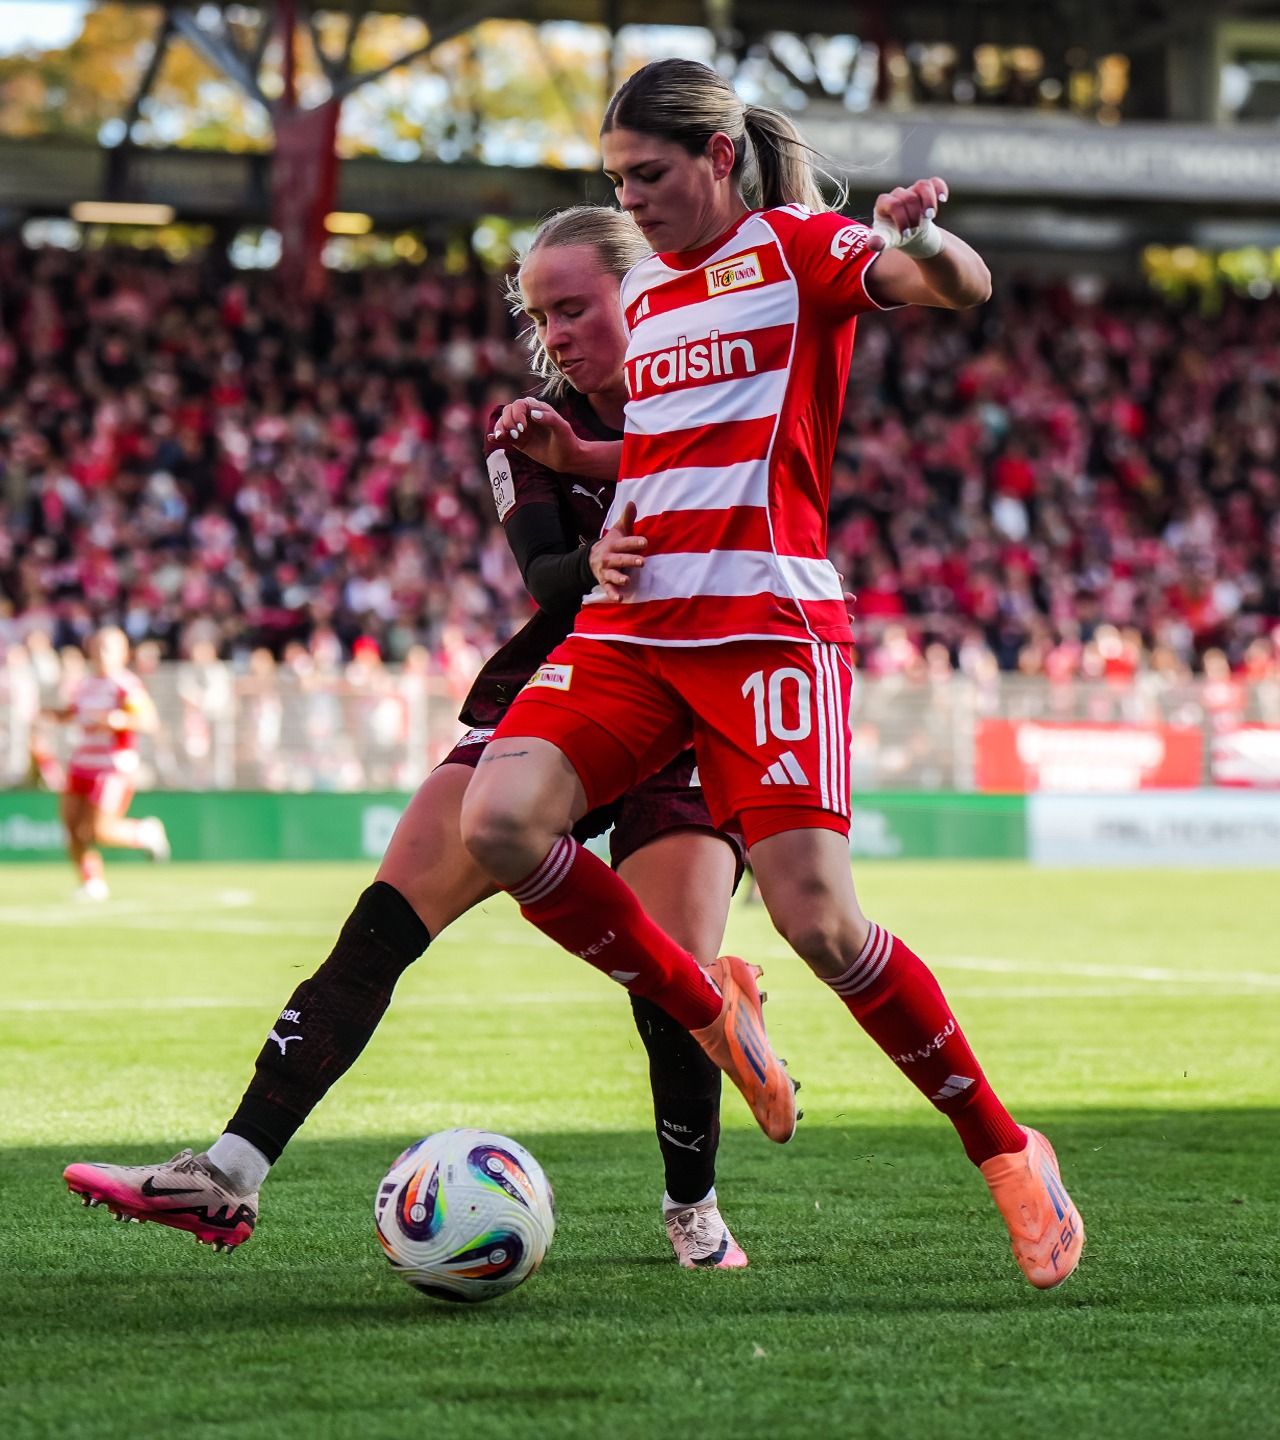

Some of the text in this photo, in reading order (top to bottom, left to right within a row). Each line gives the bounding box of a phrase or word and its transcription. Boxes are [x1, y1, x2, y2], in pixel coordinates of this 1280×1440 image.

[635, 329, 757, 393] raisin
[741, 667, 812, 747] 10
[278, 1009, 301, 1024] RBL
[663, 1119, 692, 1133] RBL
